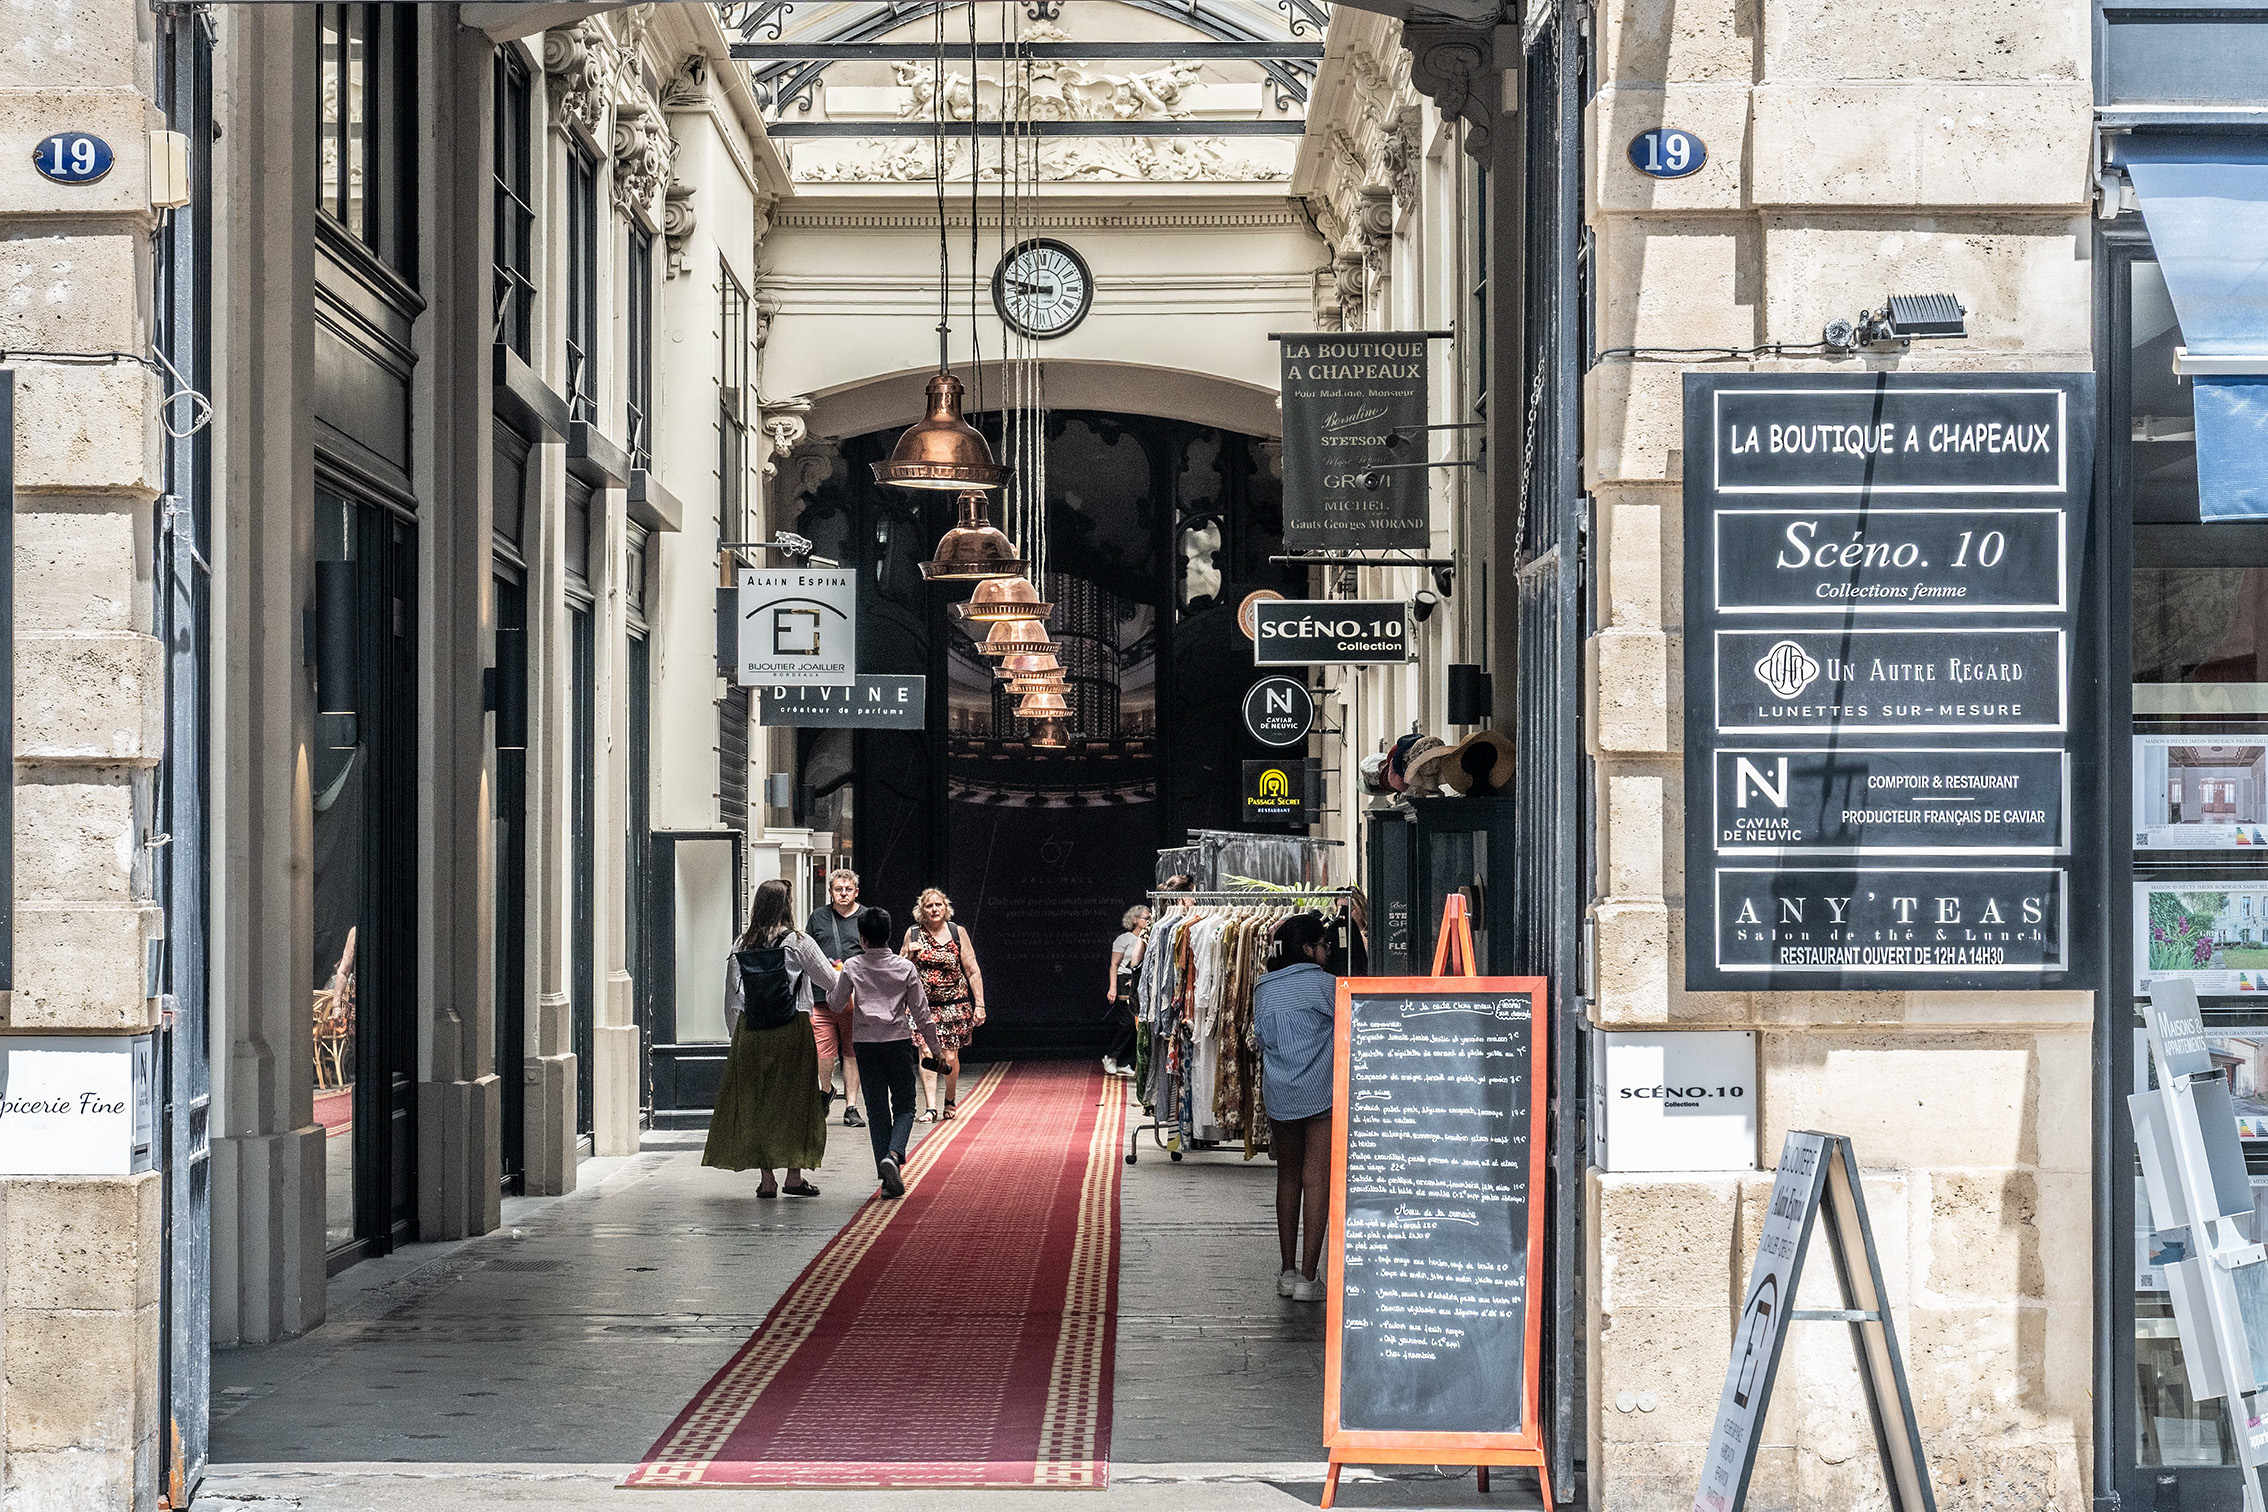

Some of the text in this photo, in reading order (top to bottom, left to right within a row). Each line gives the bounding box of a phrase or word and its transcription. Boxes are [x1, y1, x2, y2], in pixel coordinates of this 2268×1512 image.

[50, 138, 96, 174] 19
[1645, 134, 1690, 170] 19
[1286, 342, 1423, 360] LA BOUTIQUE
[1288, 364, 1421, 380] A CHAPEAUX
[1321, 436, 1387, 446] STETSON
[1732, 423, 2050, 460] LA BOUTIQUE A CHAPEAUX
[1290, 518, 1424, 531] Gants Georges MORAND
[1776, 521, 2005, 570] Scéno. 10
[1816, 583, 1967, 602] Collections femme
[1261, 615, 1402, 638] SCÉNO.10
[1337, 642, 1402, 651] Collection
[748, 662, 846, 672] BIJOUTIER JOAILLIER
[774, 686, 908, 702] DIVINE
[1266, 688, 1292, 714] N
[780, 706, 830, 714] créateur
[838, 706, 849, 714] de
[1758, 704, 2022, 718] LUNETTES SUR-MESURE
[1736, 757, 1788, 808] N
[1868, 776, 2019, 789] COMPTOIR & RESTAURANT
[1736, 818, 1790, 829] CAVIAR
[1842, 810, 2046, 826] PRODUCTEUR FRANÇAIS DE CAVIAR
[1724, 830, 1802, 841] DE NEUVIC
[1738, 929, 2043, 941] Salon de thé & Lunch
[1780, 947, 2004, 964] RESTAURANT OUVERT DE 12H A 14H30
[1620, 1084, 1744, 1099] SCÉNO.10
[0, 1092, 71, 1119] picerie
[80, 1092, 126, 1114] Fine
